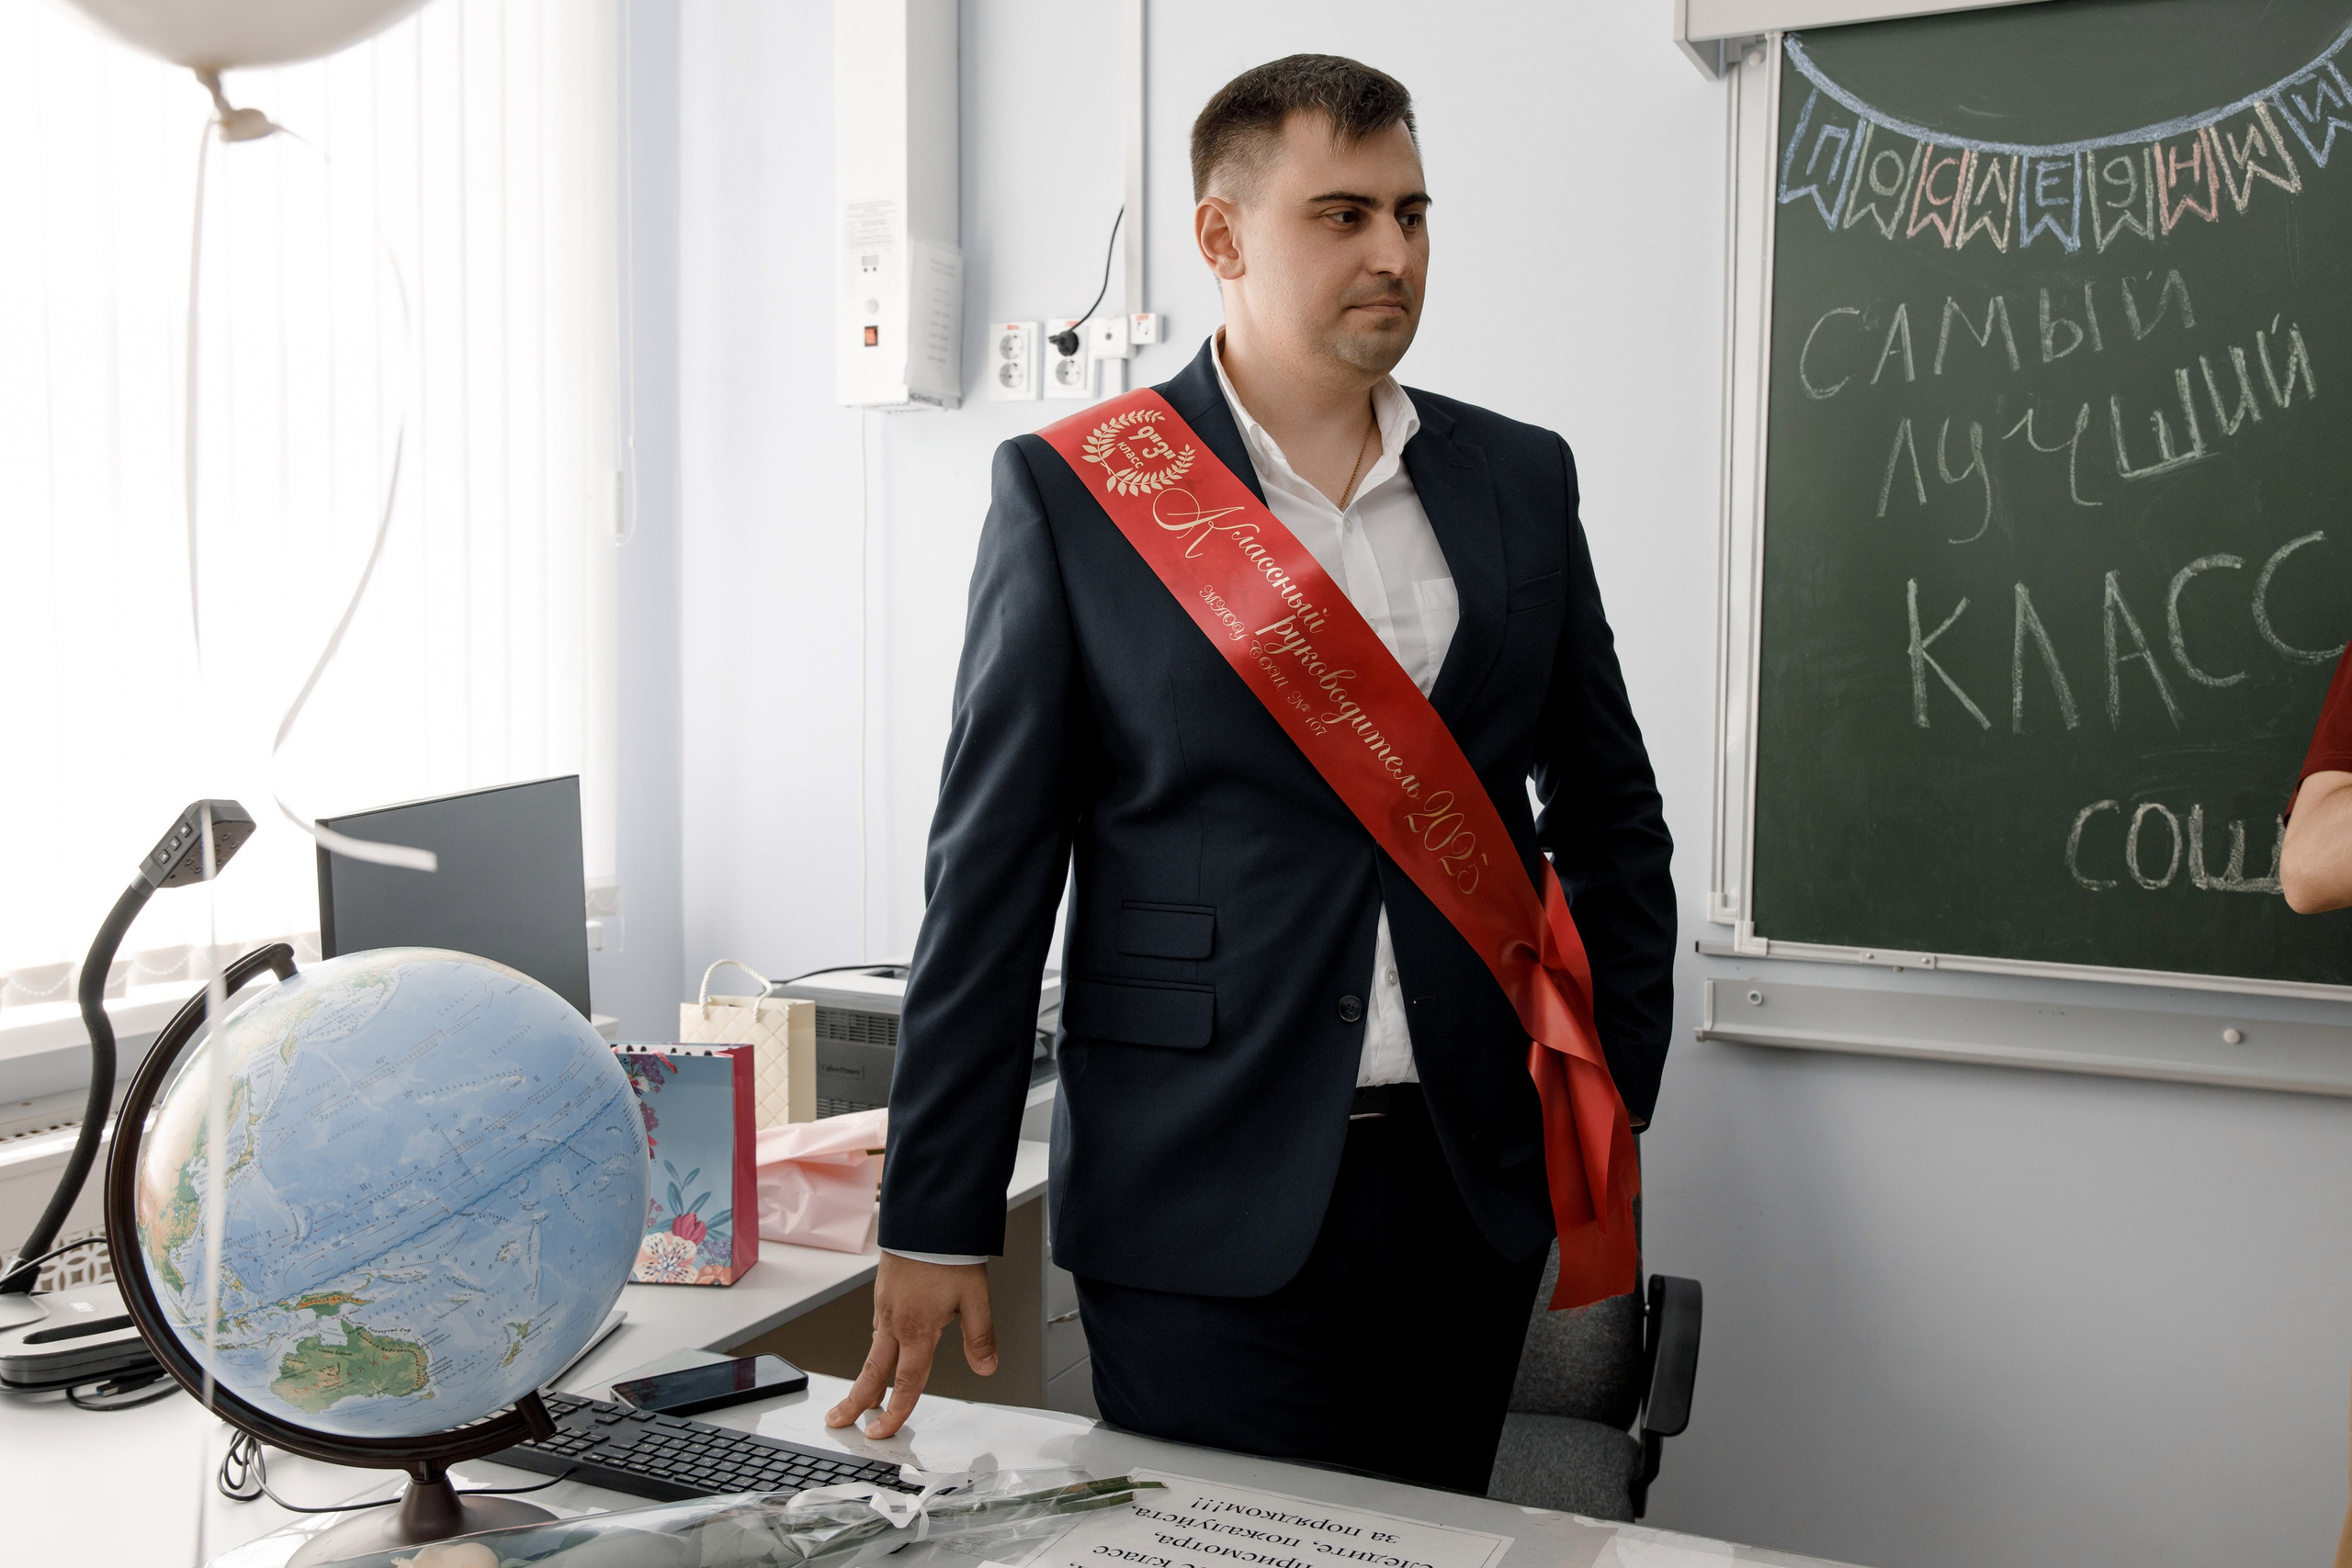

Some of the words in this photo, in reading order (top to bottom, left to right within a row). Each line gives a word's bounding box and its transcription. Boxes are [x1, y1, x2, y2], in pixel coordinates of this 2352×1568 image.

[1799, 269, 2197, 400] САМЫЙ
[1116, 441, 1145, 470] класс
[1875, 313, 2317, 544] ЛУЧШИЙ
[1152, 488, 1331, 634] Классный
[1905, 530, 2350, 734] КЛАСС
[1249, 639, 1290, 693] СОШ
[1305, 713, 1328, 737] 107
[1254, 614, 1421, 800] руководитель
[1403, 790, 1492, 896] 2025
[1131, 1505, 1303, 1548] пожалуйста,
[1190, 1497, 1363, 1538] порядком!!!
[1370, 1530, 1401, 1545] за
